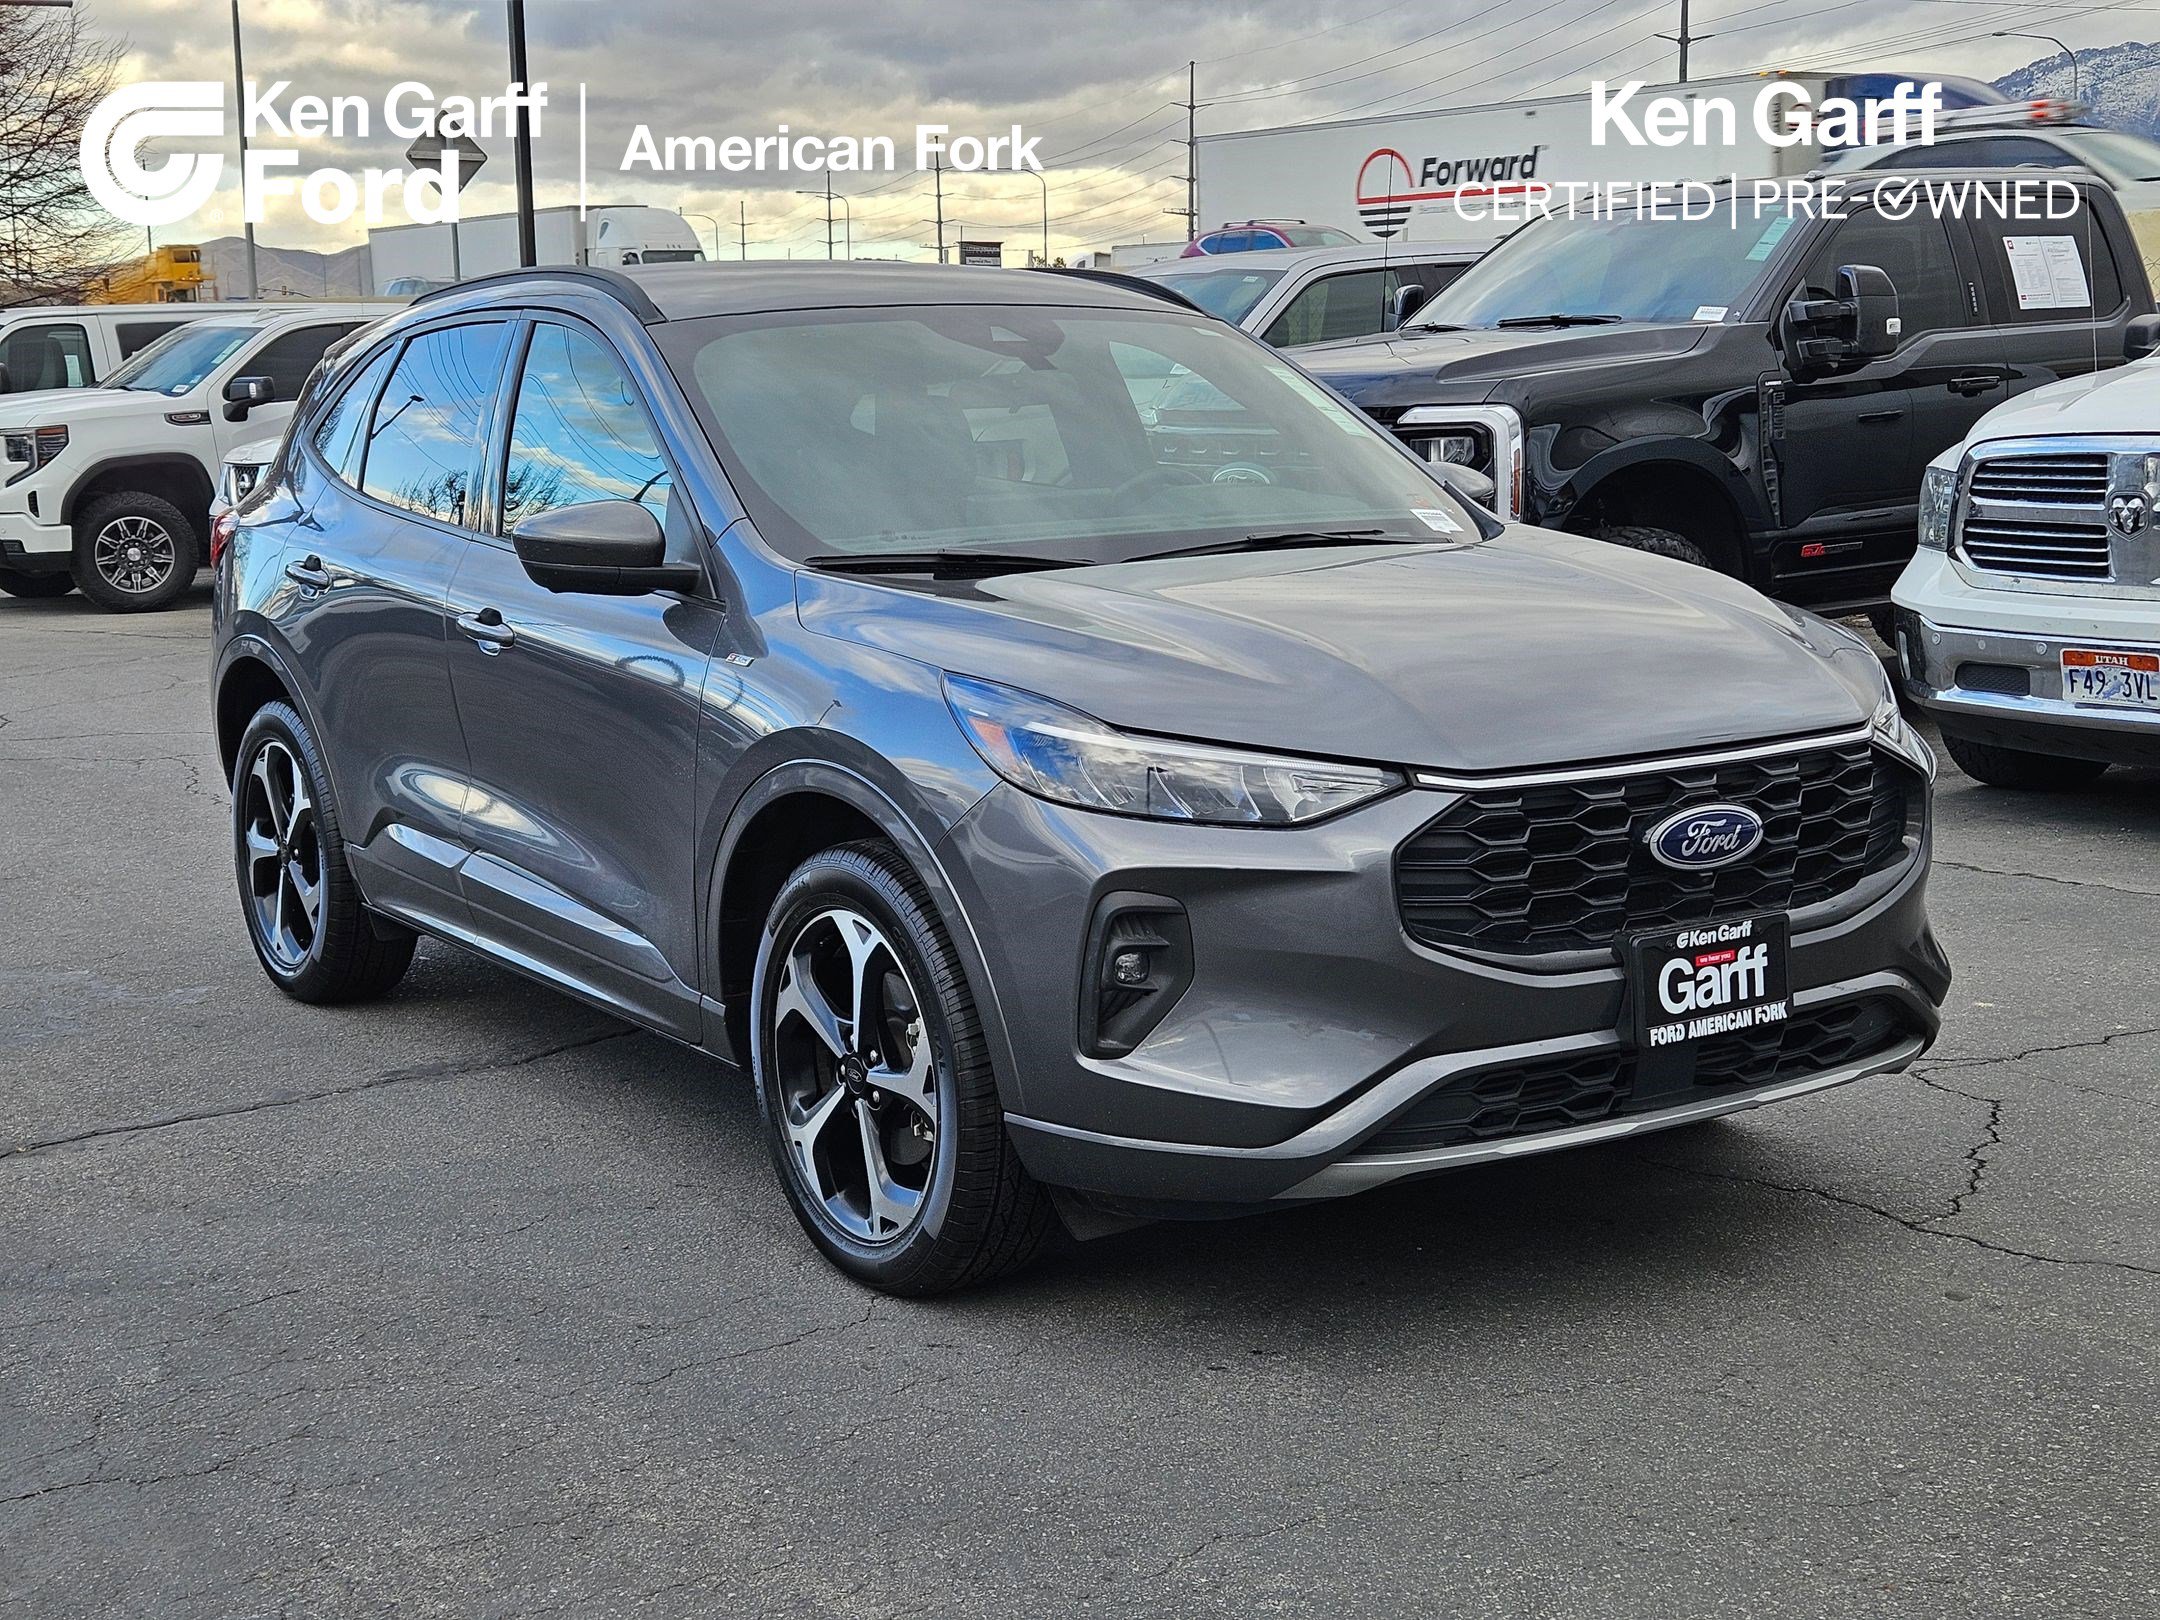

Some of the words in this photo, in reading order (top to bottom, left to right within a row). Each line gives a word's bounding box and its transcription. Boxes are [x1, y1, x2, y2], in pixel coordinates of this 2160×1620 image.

[1419, 145, 1546, 187] Forward
[2095, 654, 2129, 666] UTAH
[2068, 668, 2106, 696] F49
[2120, 671, 2158, 701] 3VL
[1681, 818, 1742, 857] Ford
[1689, 929, 1717, 948] Ken
[1718, 920, 1752, 941] Garff
[1658, 943, 1768, 1015] Garff
[1650, 1023, 1685, 1047] FORD
[1688, 1009, 1752, 1039] AMERICAN
[1755, 1001, 1787, 1025] FORK
